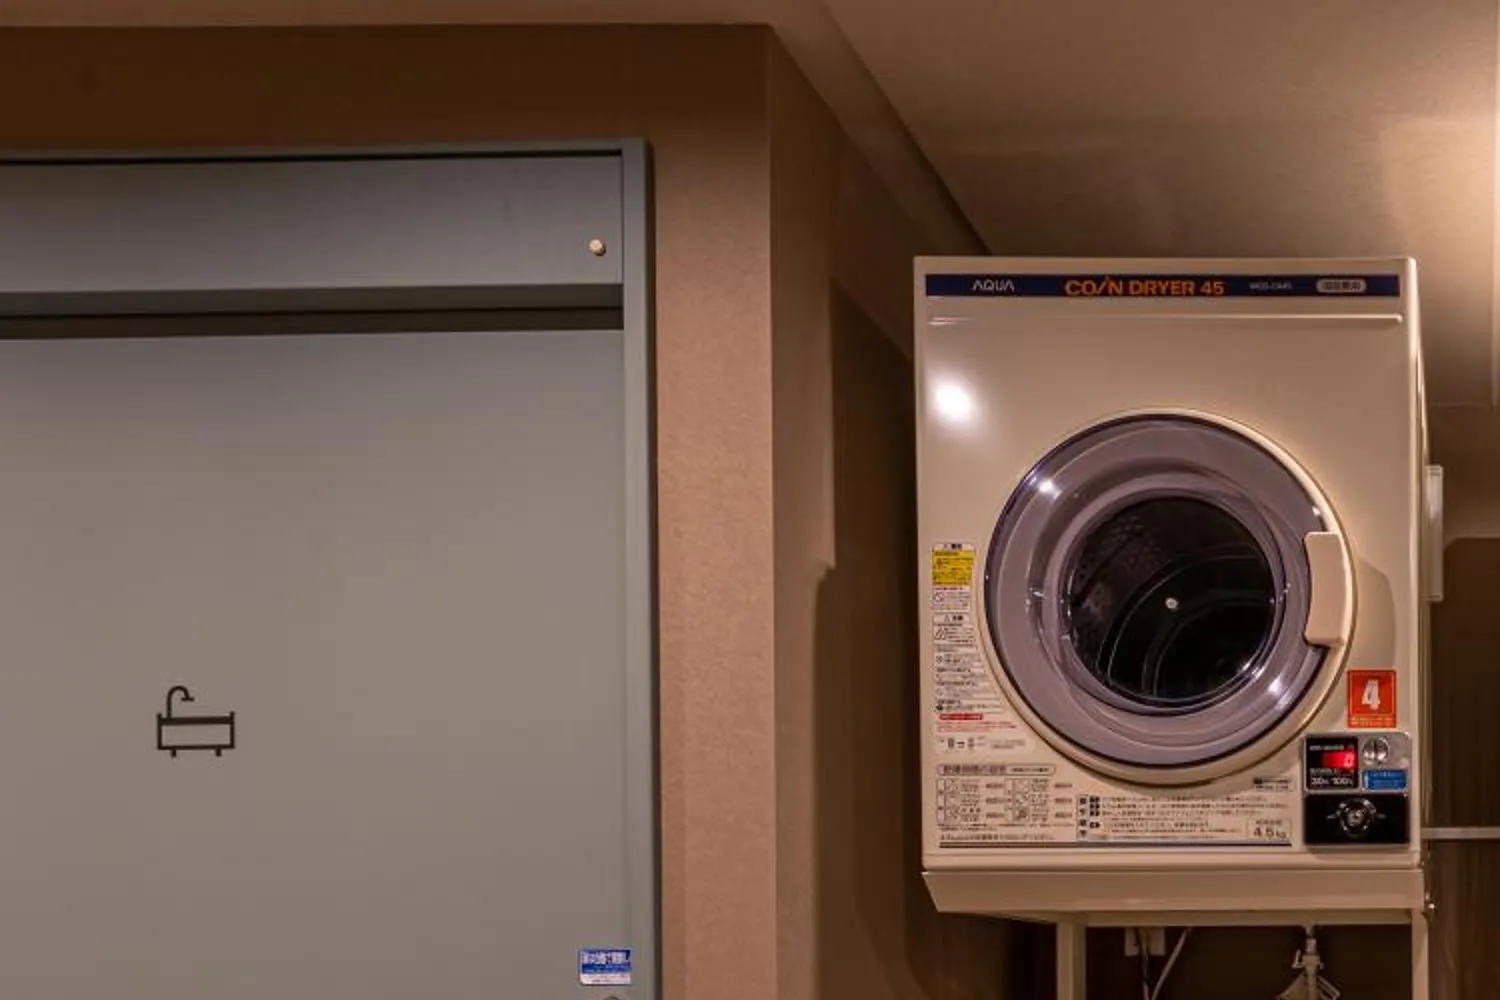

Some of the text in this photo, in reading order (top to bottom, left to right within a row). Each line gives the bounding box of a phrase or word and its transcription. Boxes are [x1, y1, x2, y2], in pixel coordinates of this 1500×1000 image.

[972, 279, 1015, 292] AQUA
[1128, 280, 1195, 296] DRYER
[1200, 281, 1225, 296] 45
[1361, 679, 1381, 710] 4
